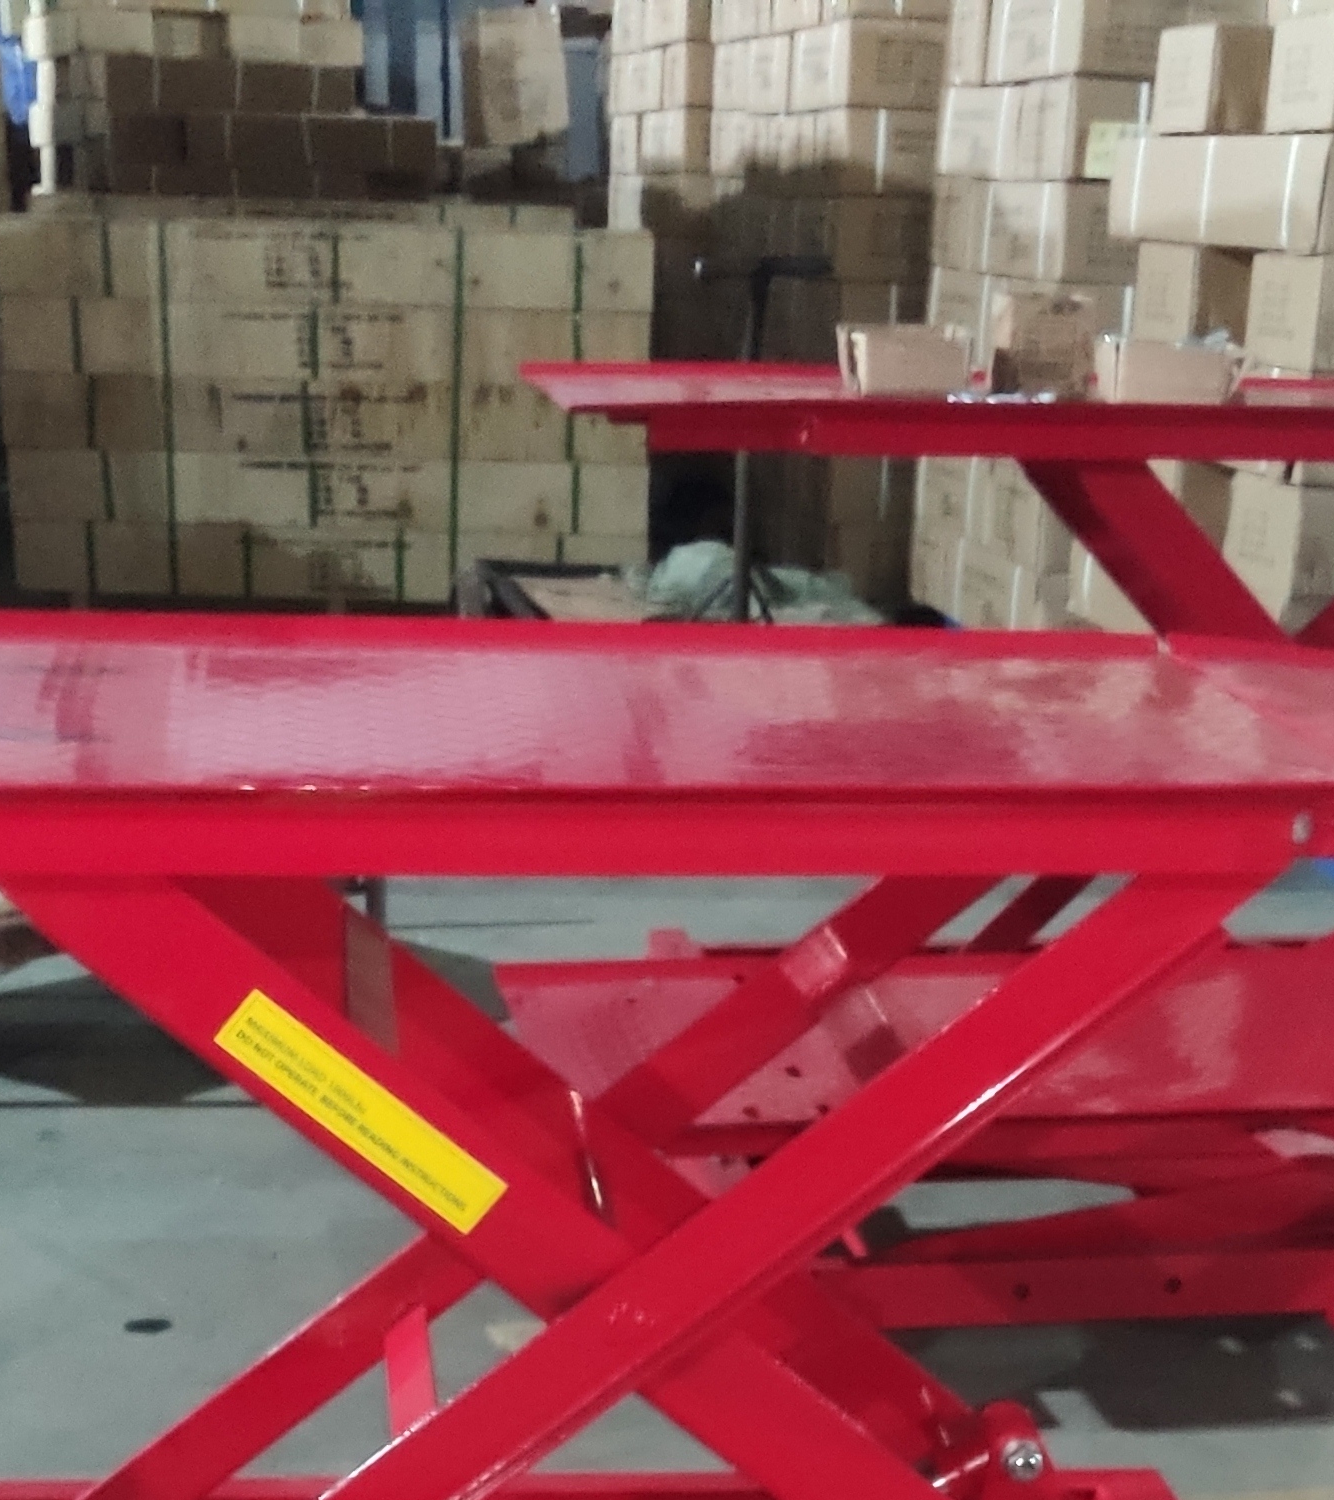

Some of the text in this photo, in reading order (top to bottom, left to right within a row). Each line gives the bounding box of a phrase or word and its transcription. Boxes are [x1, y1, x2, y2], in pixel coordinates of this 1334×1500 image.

[235, 1029, 254, 1046] DO
[251, 1042, 275, 1062] NOT
[273, 1058, 319, 1096] OPERATE
[318, 1093, 357, 1126] BEFORE
[356, 1122, 401, 1160] READING
